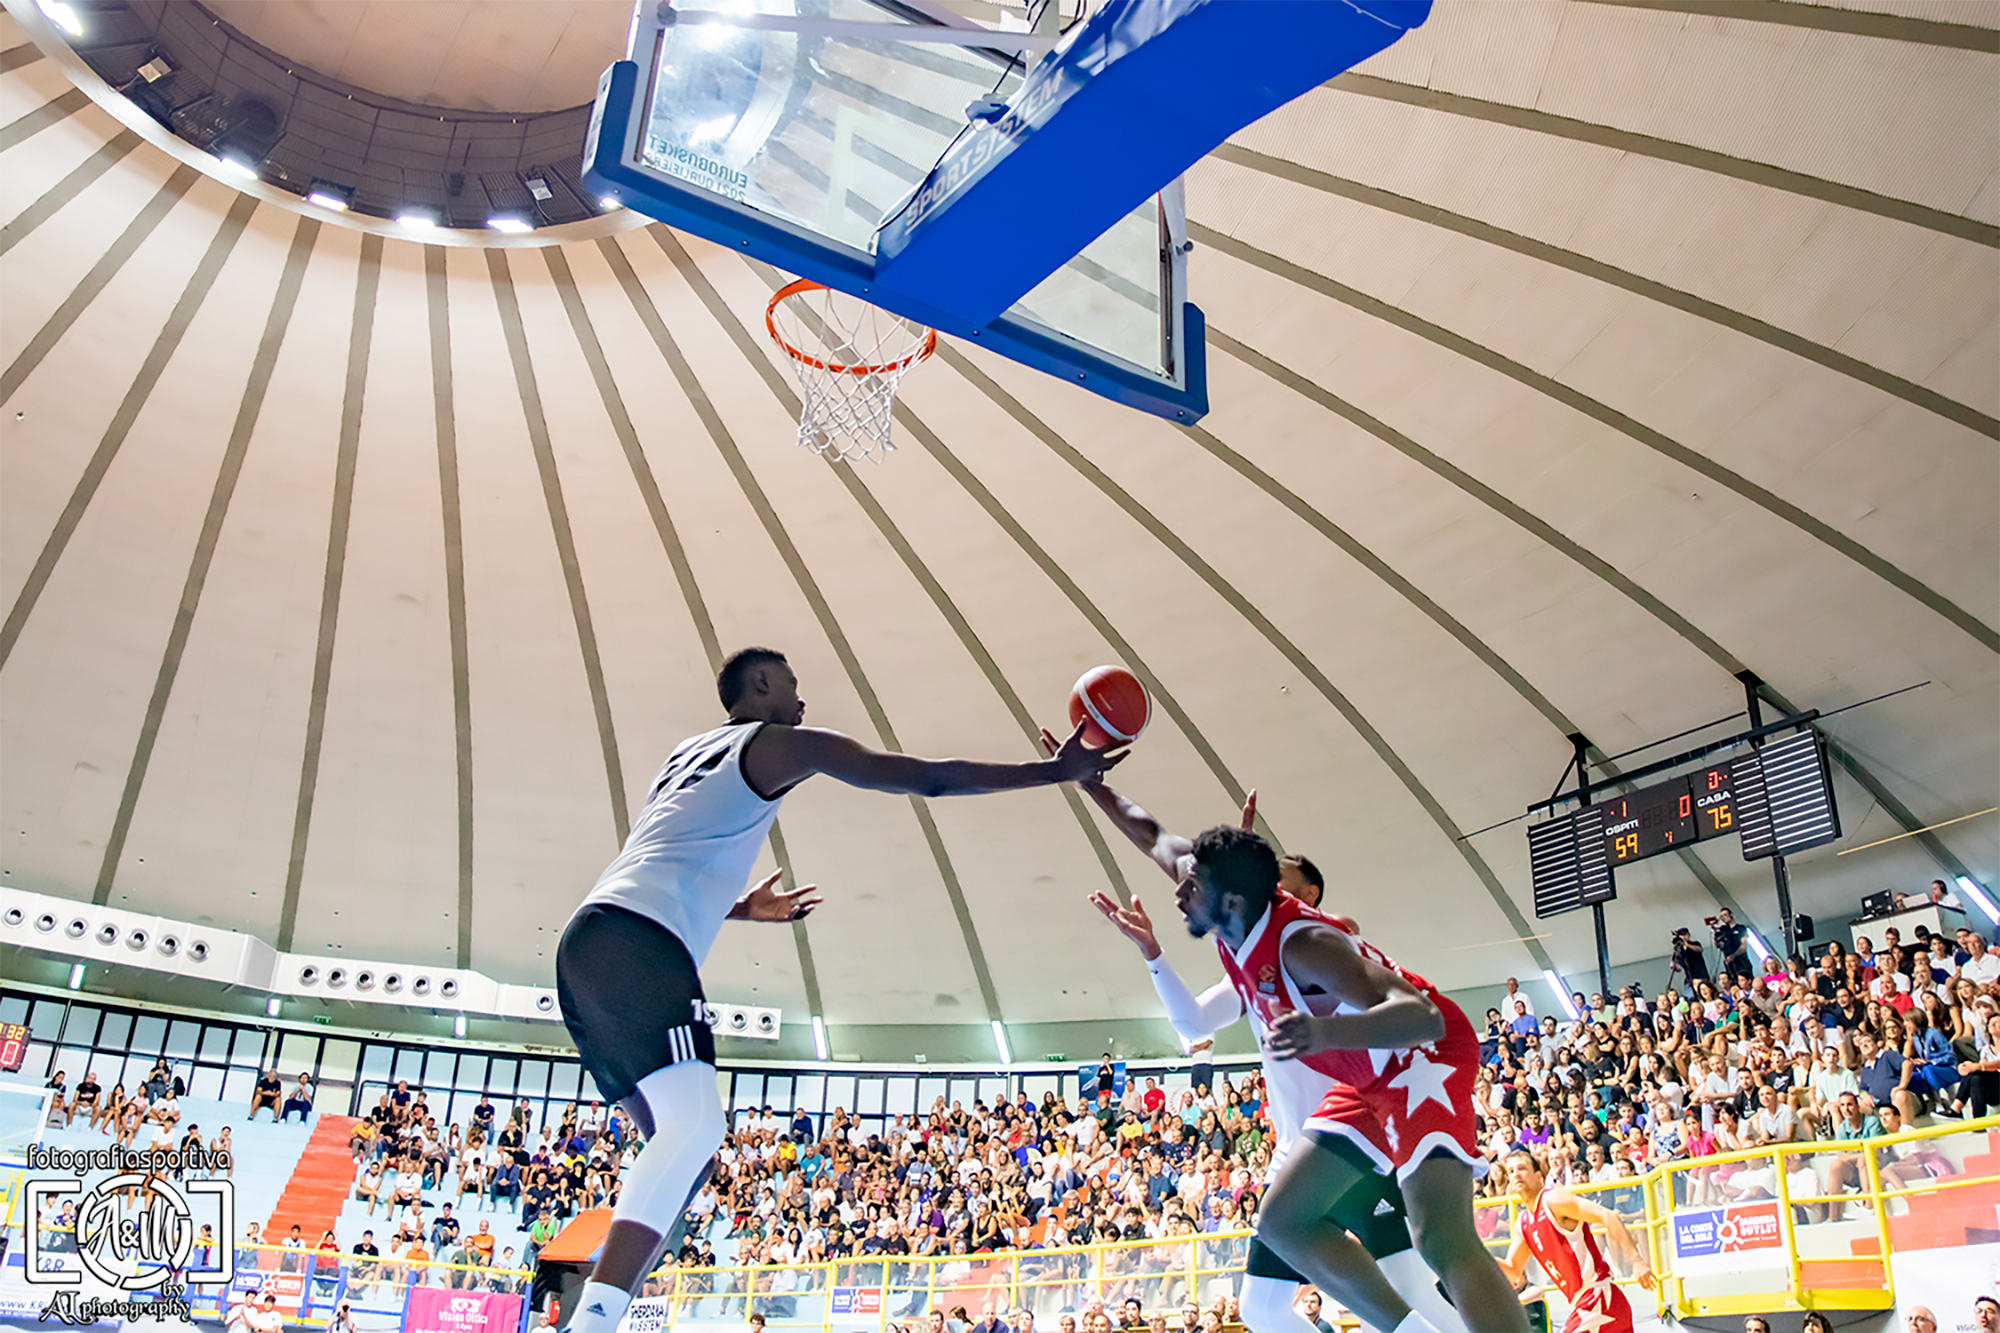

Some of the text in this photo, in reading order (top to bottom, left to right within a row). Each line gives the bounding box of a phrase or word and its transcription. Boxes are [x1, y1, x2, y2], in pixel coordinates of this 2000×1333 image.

[1696, 790, 1732, 808] CASA
[1706, 804, 1733, 830] 75
[1615, 832, 1639, 859] 59
[1678, 1225, 1690, 1235] LA
[1739, 1223, 1777, 1237] OUTLET
